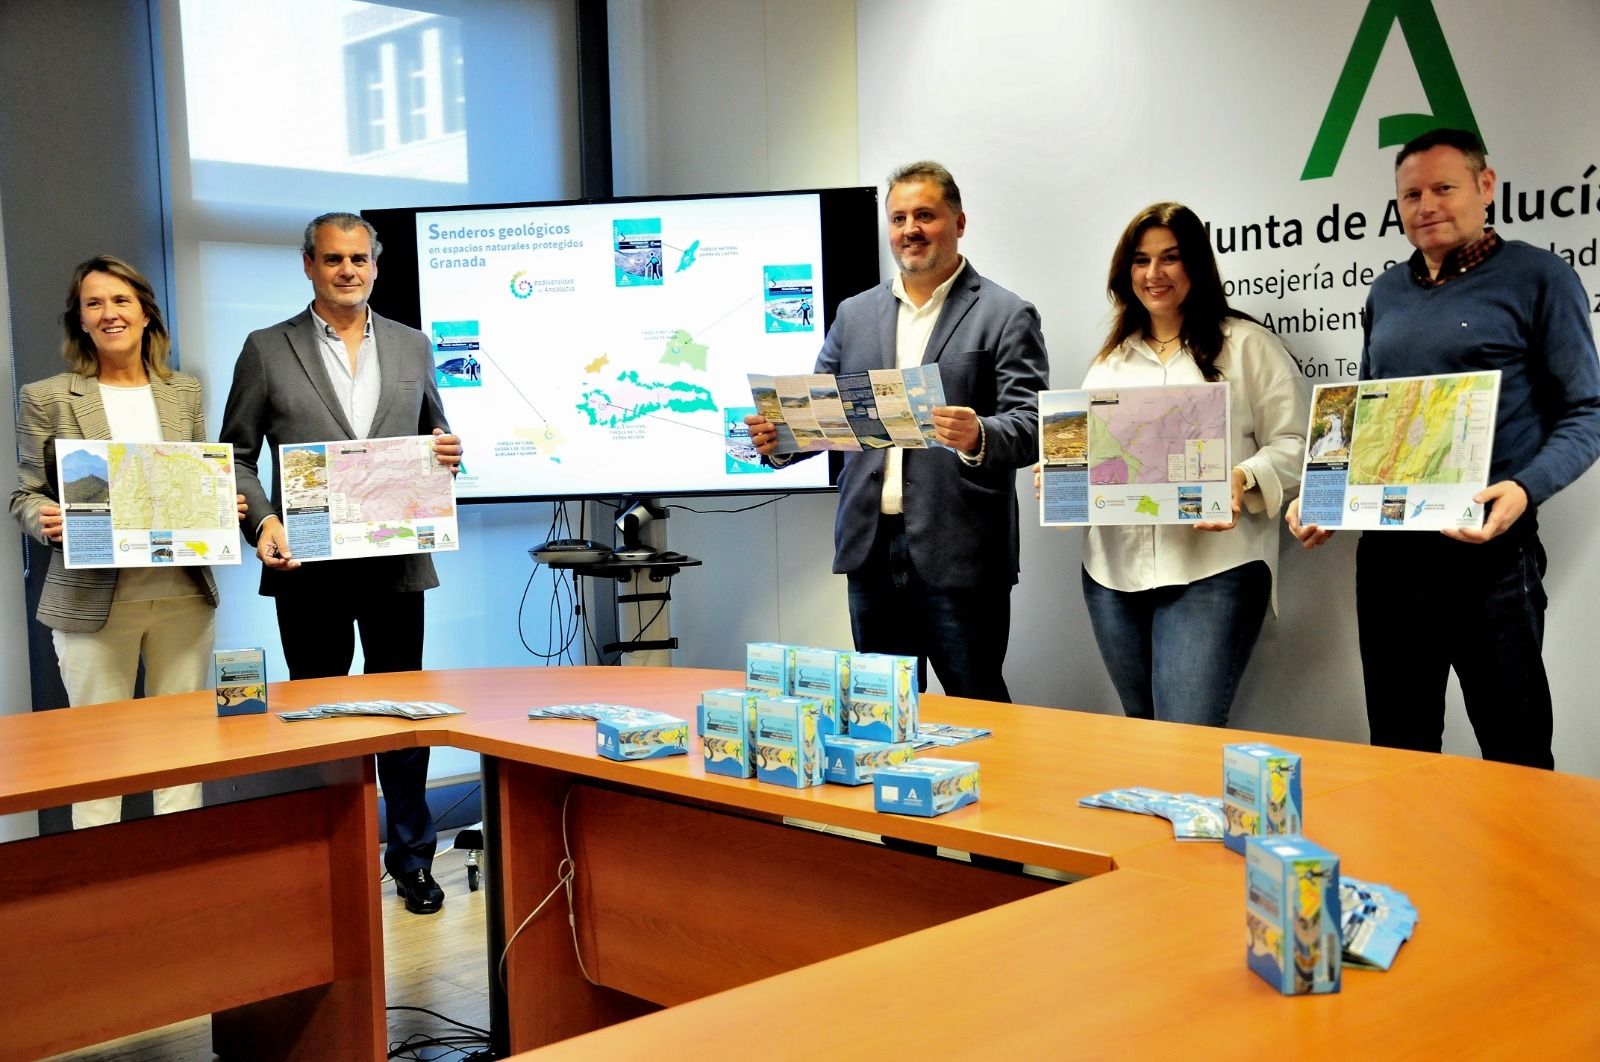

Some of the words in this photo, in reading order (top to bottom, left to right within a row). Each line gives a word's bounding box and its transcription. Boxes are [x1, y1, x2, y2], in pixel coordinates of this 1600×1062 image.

[428, 223, 496, 240] Senderos
[498, 222, 571, 240] geológicos
[1316, 203, 1367, 244] de
[429, 245, 441, 254] en
[442, 243, 483, 255] espacios
[485, 241, 530, 252] naturales
[532, 239, 584, 251] protegidos
[429, 256, 487, 269] Granada
[1223, 262, 1334, 300] onsejería
[1342, 261, 1375, 288] de
